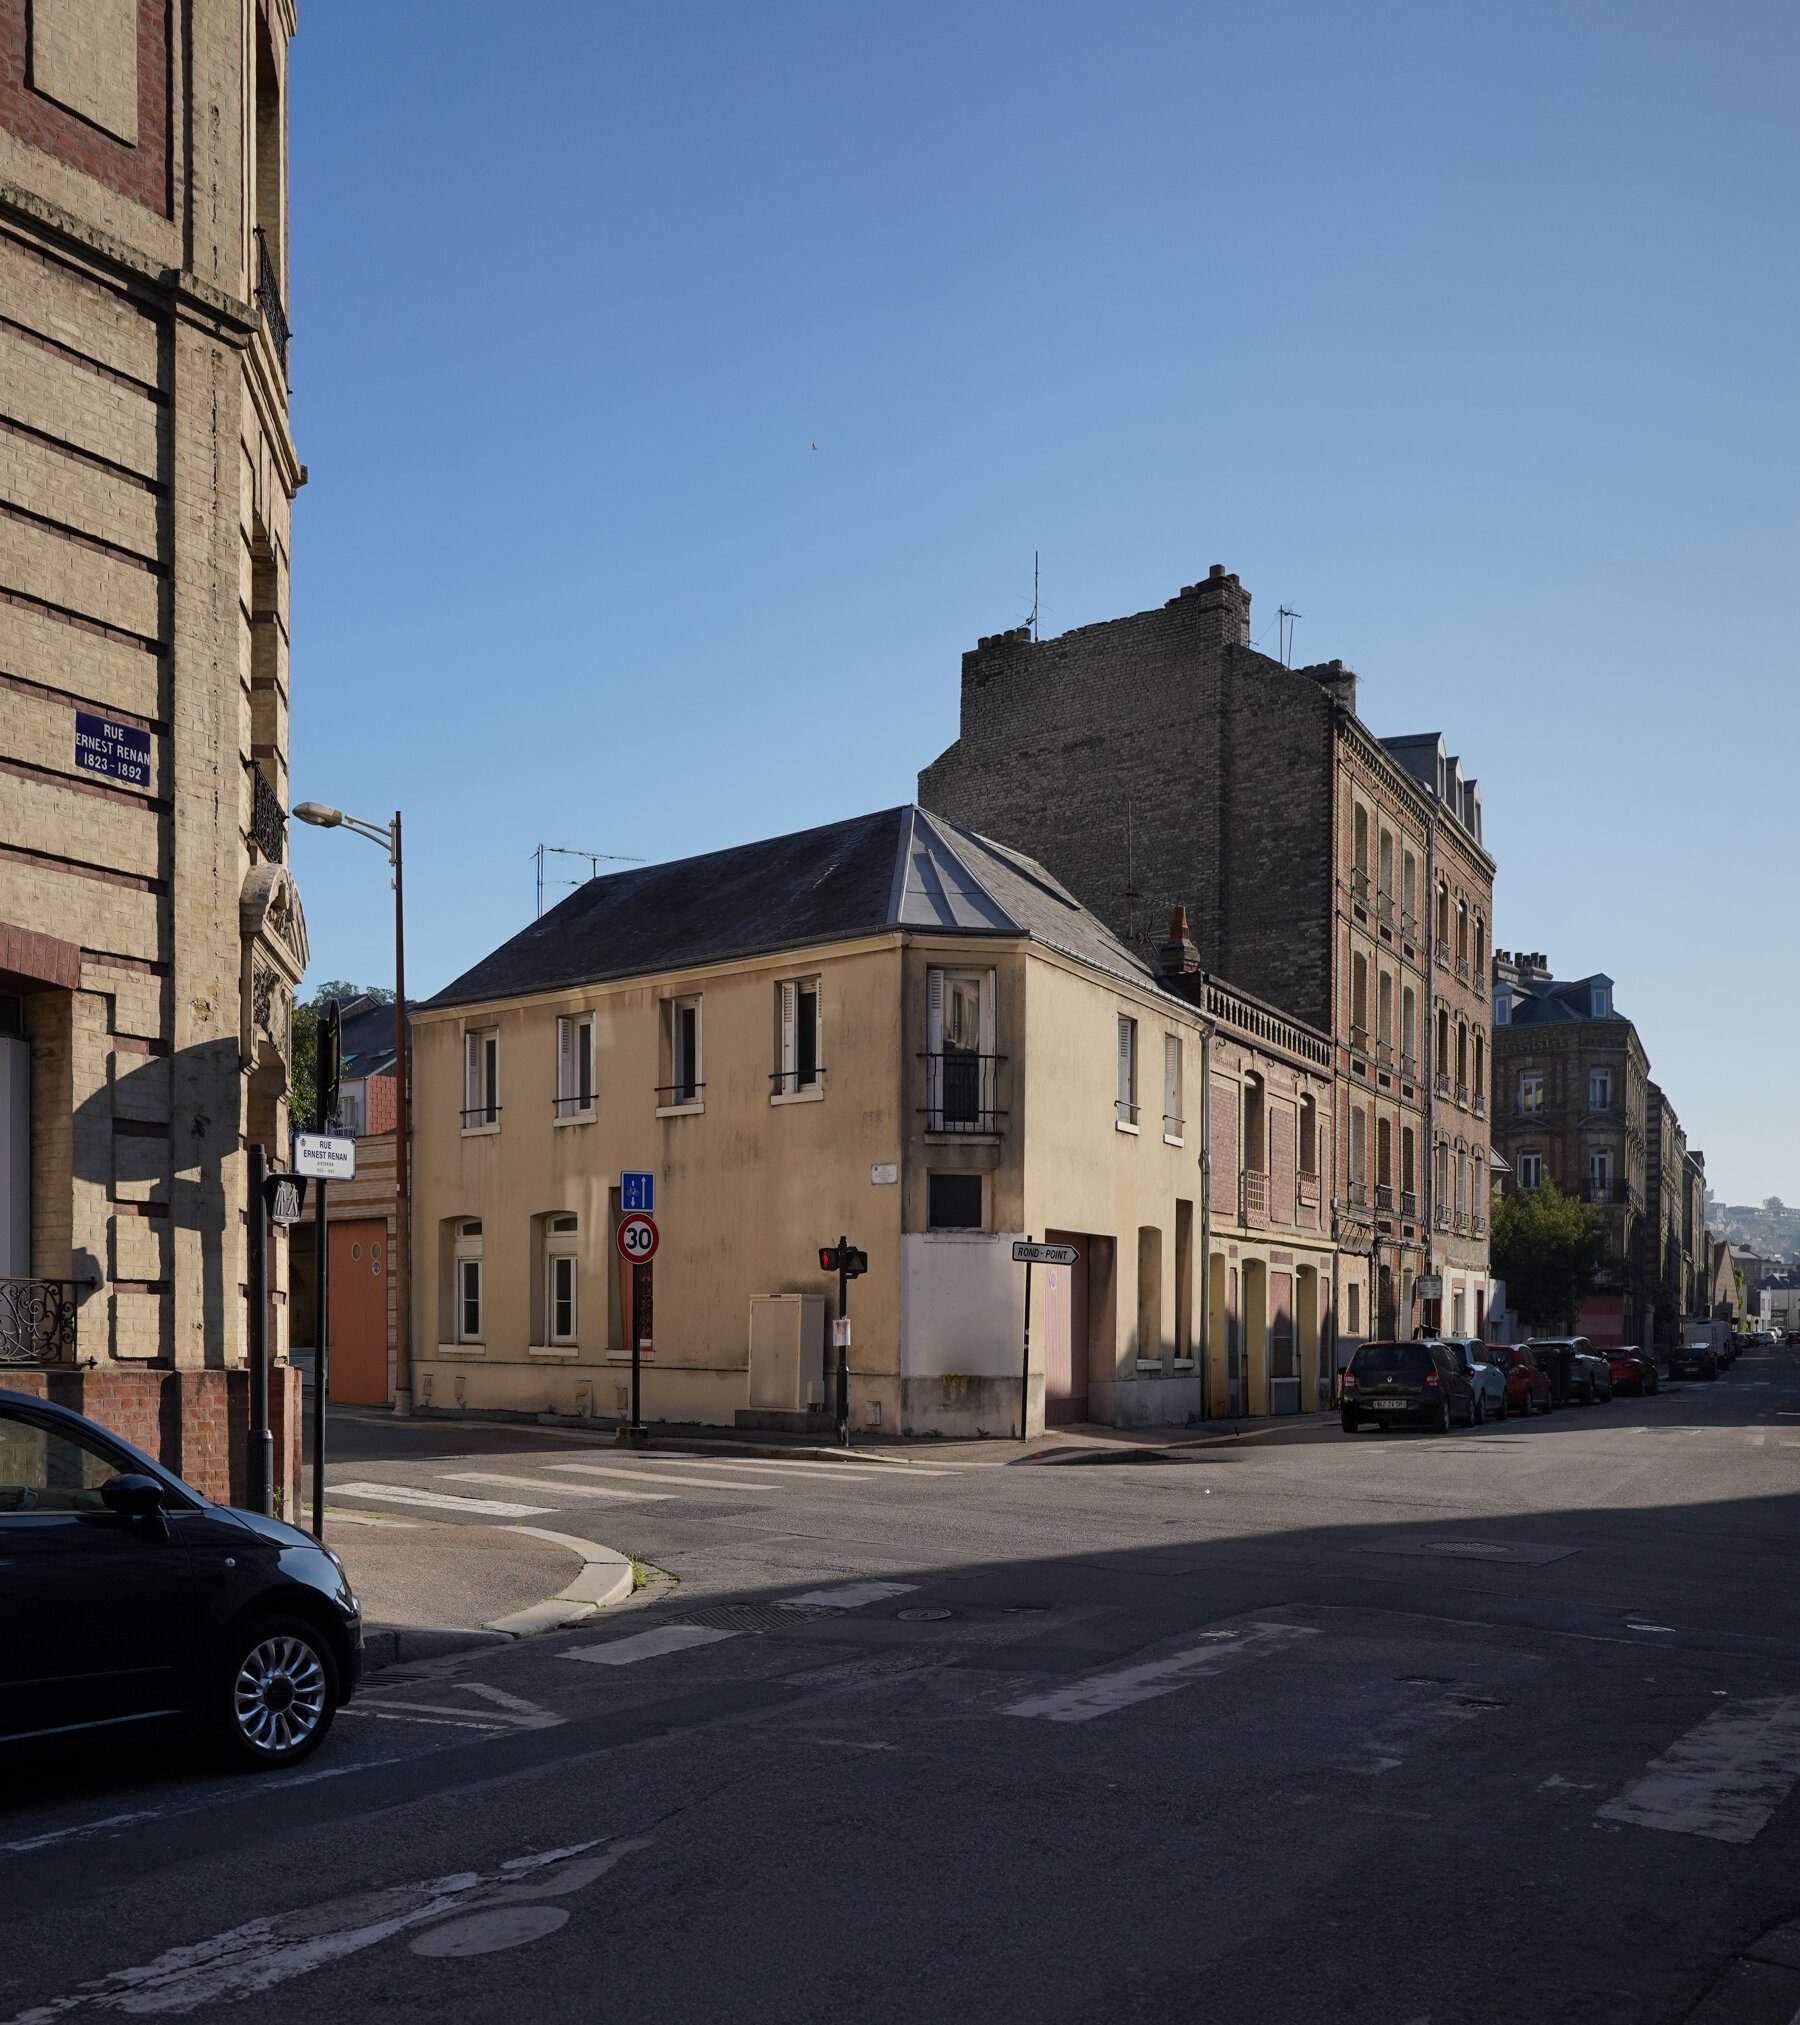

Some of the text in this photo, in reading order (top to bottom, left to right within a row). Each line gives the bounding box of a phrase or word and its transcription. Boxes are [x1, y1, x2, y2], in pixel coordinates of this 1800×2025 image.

[104, 724, 124, 741] RUE
[76, 733, 150, 766] ERNEST RENAN
[84, 752, 108, 770] 1823
[118, 762, 142, 780] 1892
[320, 1141, 332, 1149] RUE
[303, 1150, 348, 1161] ERNEST RENAN
[626, 1227, 652, 1250] 30
[1018, 1247, 1040, 1258] ROND
[1046, 1250, 1068, 1260] POINT
